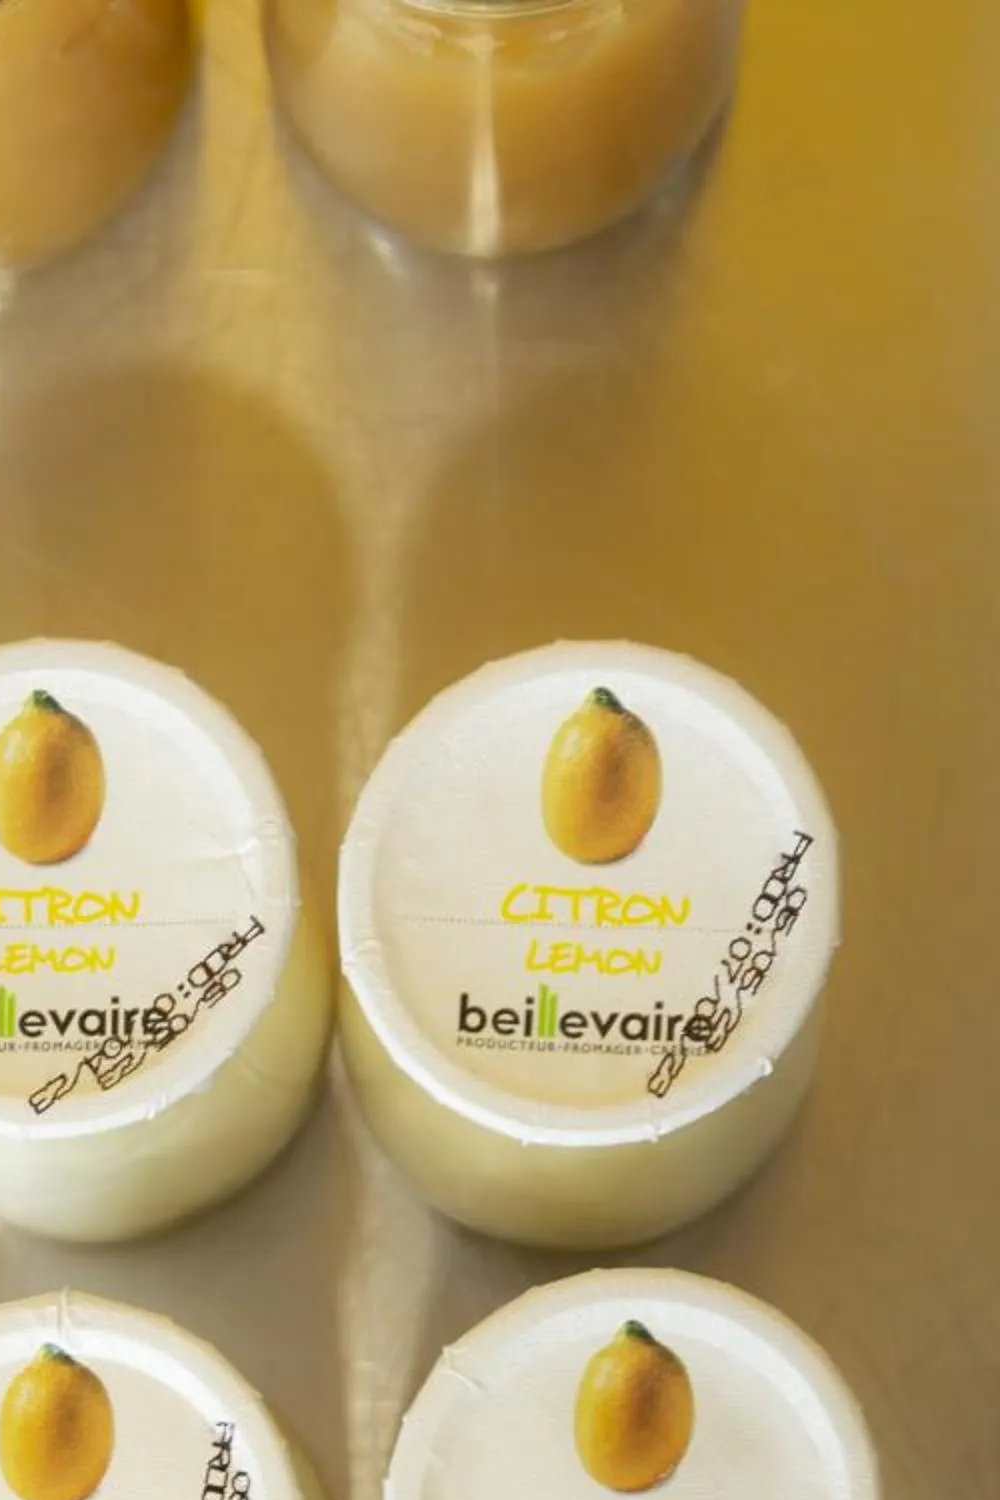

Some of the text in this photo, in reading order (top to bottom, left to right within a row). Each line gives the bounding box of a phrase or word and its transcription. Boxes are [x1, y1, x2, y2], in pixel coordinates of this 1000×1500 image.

[500, 883, 691, 927] CITRON
[525, 940, 662, 975] LEMON
[458, 983, 714, 1042] beillevaire
